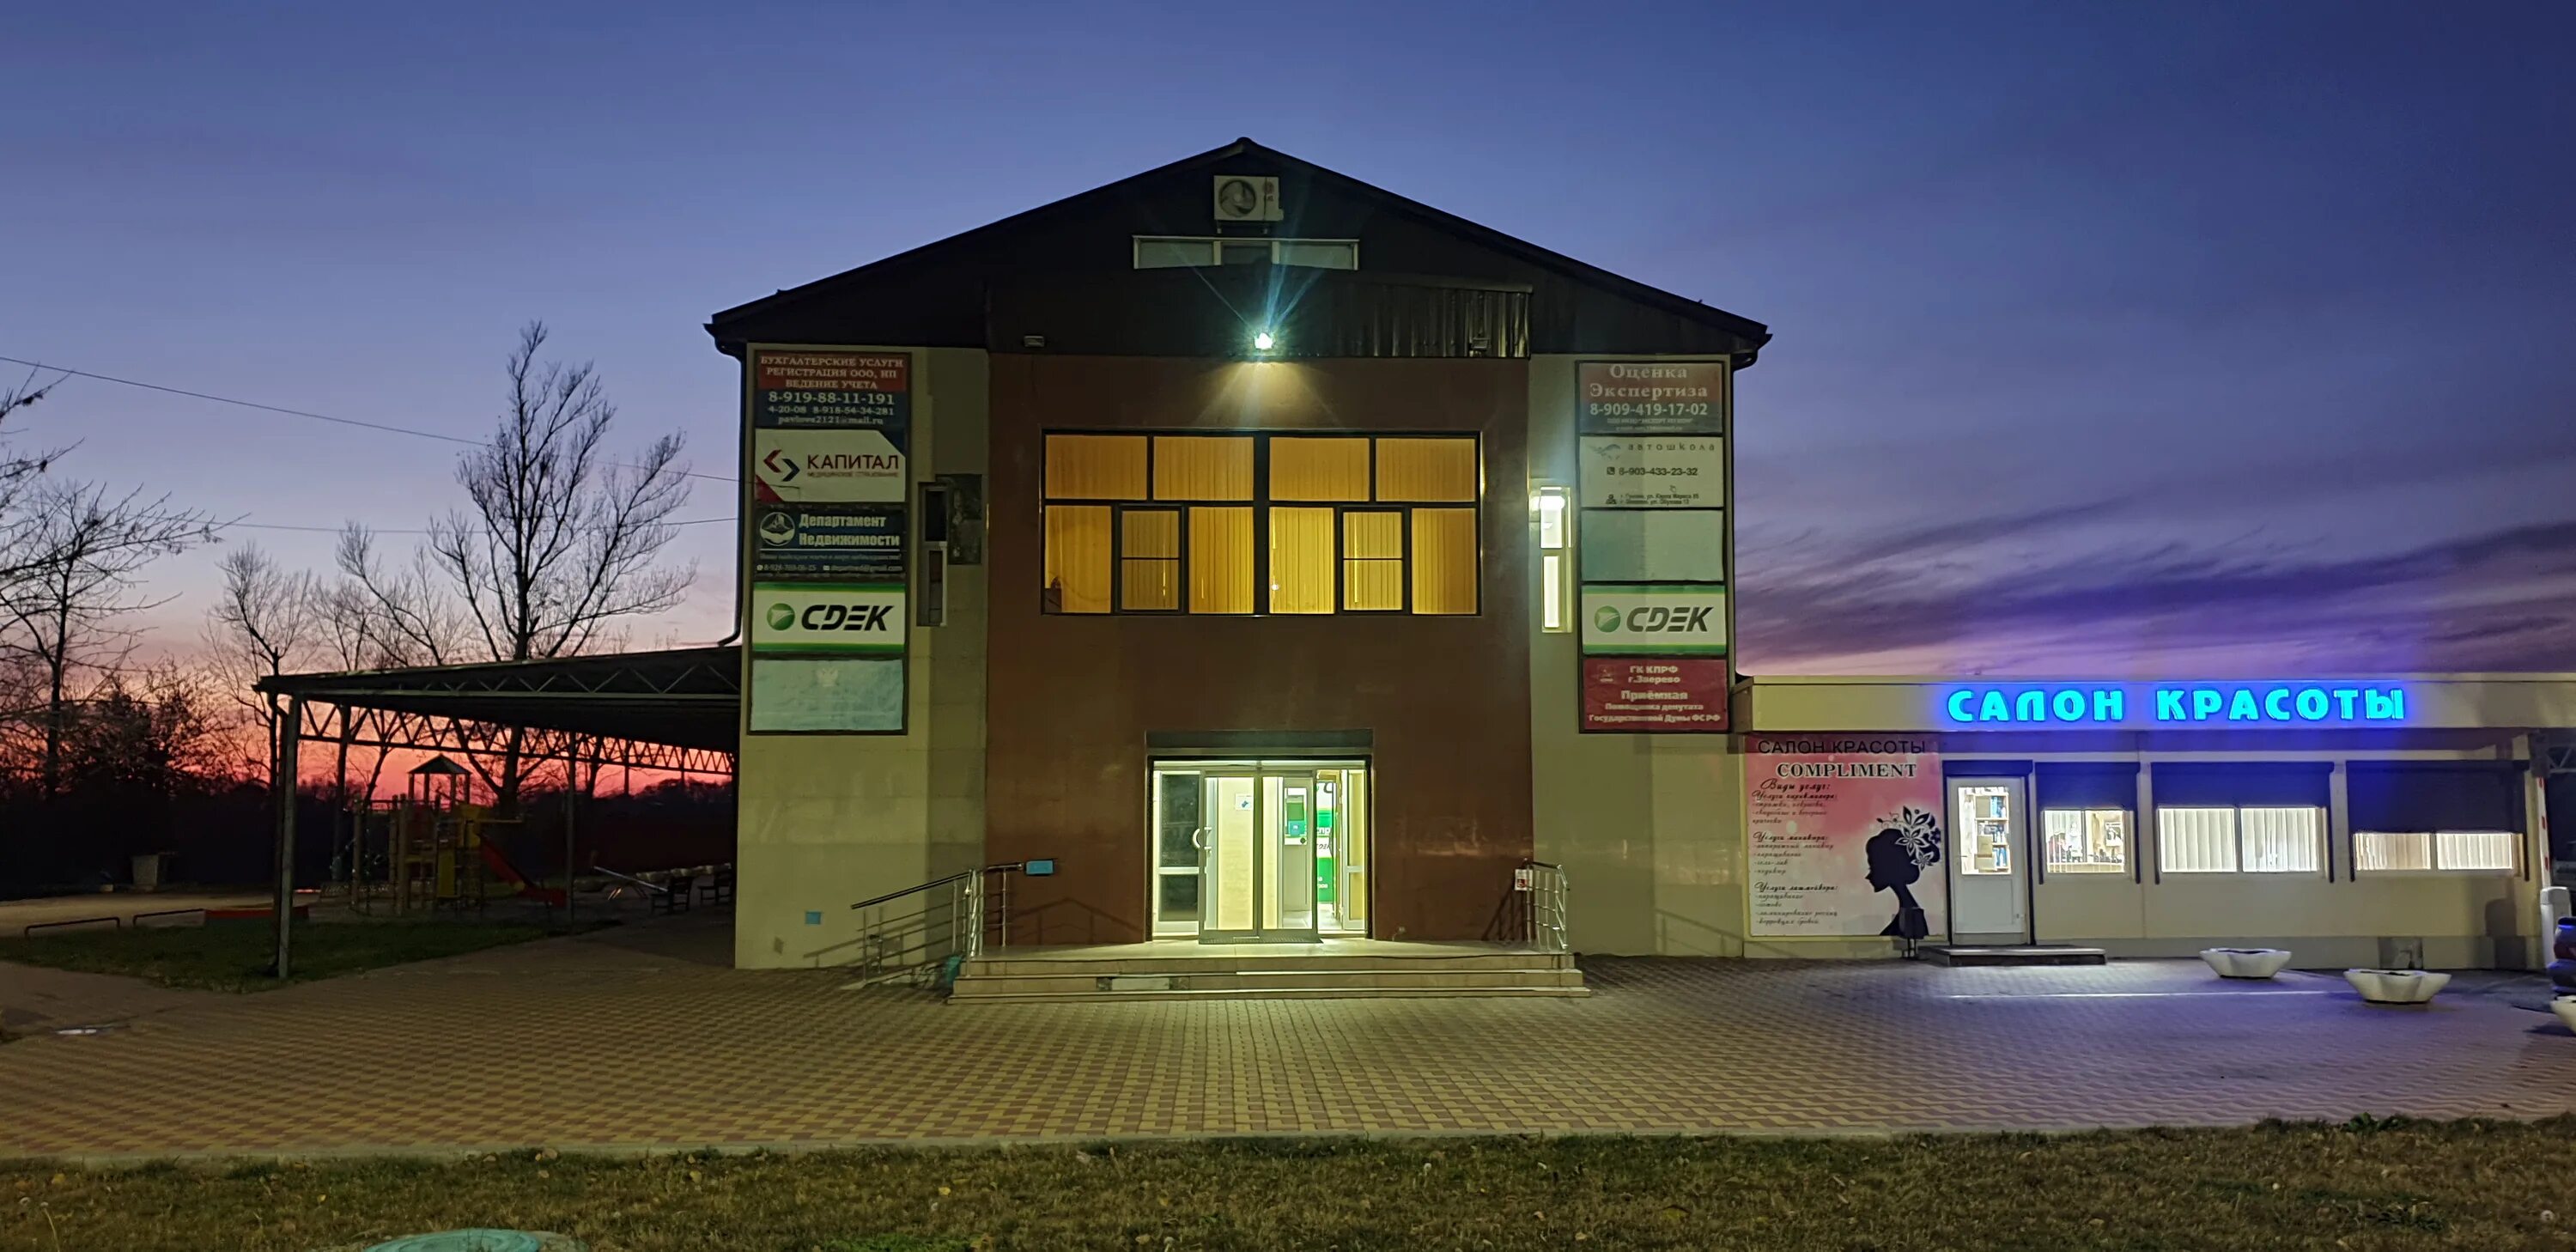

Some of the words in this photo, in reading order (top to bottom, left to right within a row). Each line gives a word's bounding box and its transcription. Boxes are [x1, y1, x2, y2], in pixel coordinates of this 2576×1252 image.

[761, 356, 855, 366] БУХГАЛТЕРСКИЕ
[860, 358, 903, 368] УСЛУГИ
[767, 368, 847, 378] РЕГИСТРАЦИЯ
[850, 369, 878, 379] ООО,
[1610, 364, 1687, 380] Оценка
[786, 380, 838, 388] ВЕДЕНИЕ
[841, 380, 878, 389] УЧЕТА
[769, 392, 895, 404] 8-919-88-11-191
[1590, 383, 1708, 401] Экспертиза
[1590, 404, 1708, 416] 8-909-419-17-02
[807, 455, 899, 469] КАПИТАЛ
[799, 514, 886, 527] Департамент
[799, 533, 900, 546] Недвижимости
[801, 605, 895, 631] CDEK
[1626, 607, 1714, 632] CDEK
[1630, 666, 1643, 674] ГК
[1646, 666, 1679, 674] КПРФ
[1947, 689, 2124, 723] САЛОН
[2156, 688, 2404, 721] КРАСОТЫ
[1664, 714, 1691, 723] Думы
[1758, 740, 1826, 754] САЛОН
[1832, 741, 1925, 754] КРАСОТЫ
[1777, 763, 1917, 777] COMPLIMENT
[1760, 779, 1795, 793] Виды
[1799, 783, 1831, 793] услуг:
[1751, 790, 1783, 802] Услуги
[1753, 831, 1784, 842] Услуги
[1753, 881, 1786, 893] Услуги
